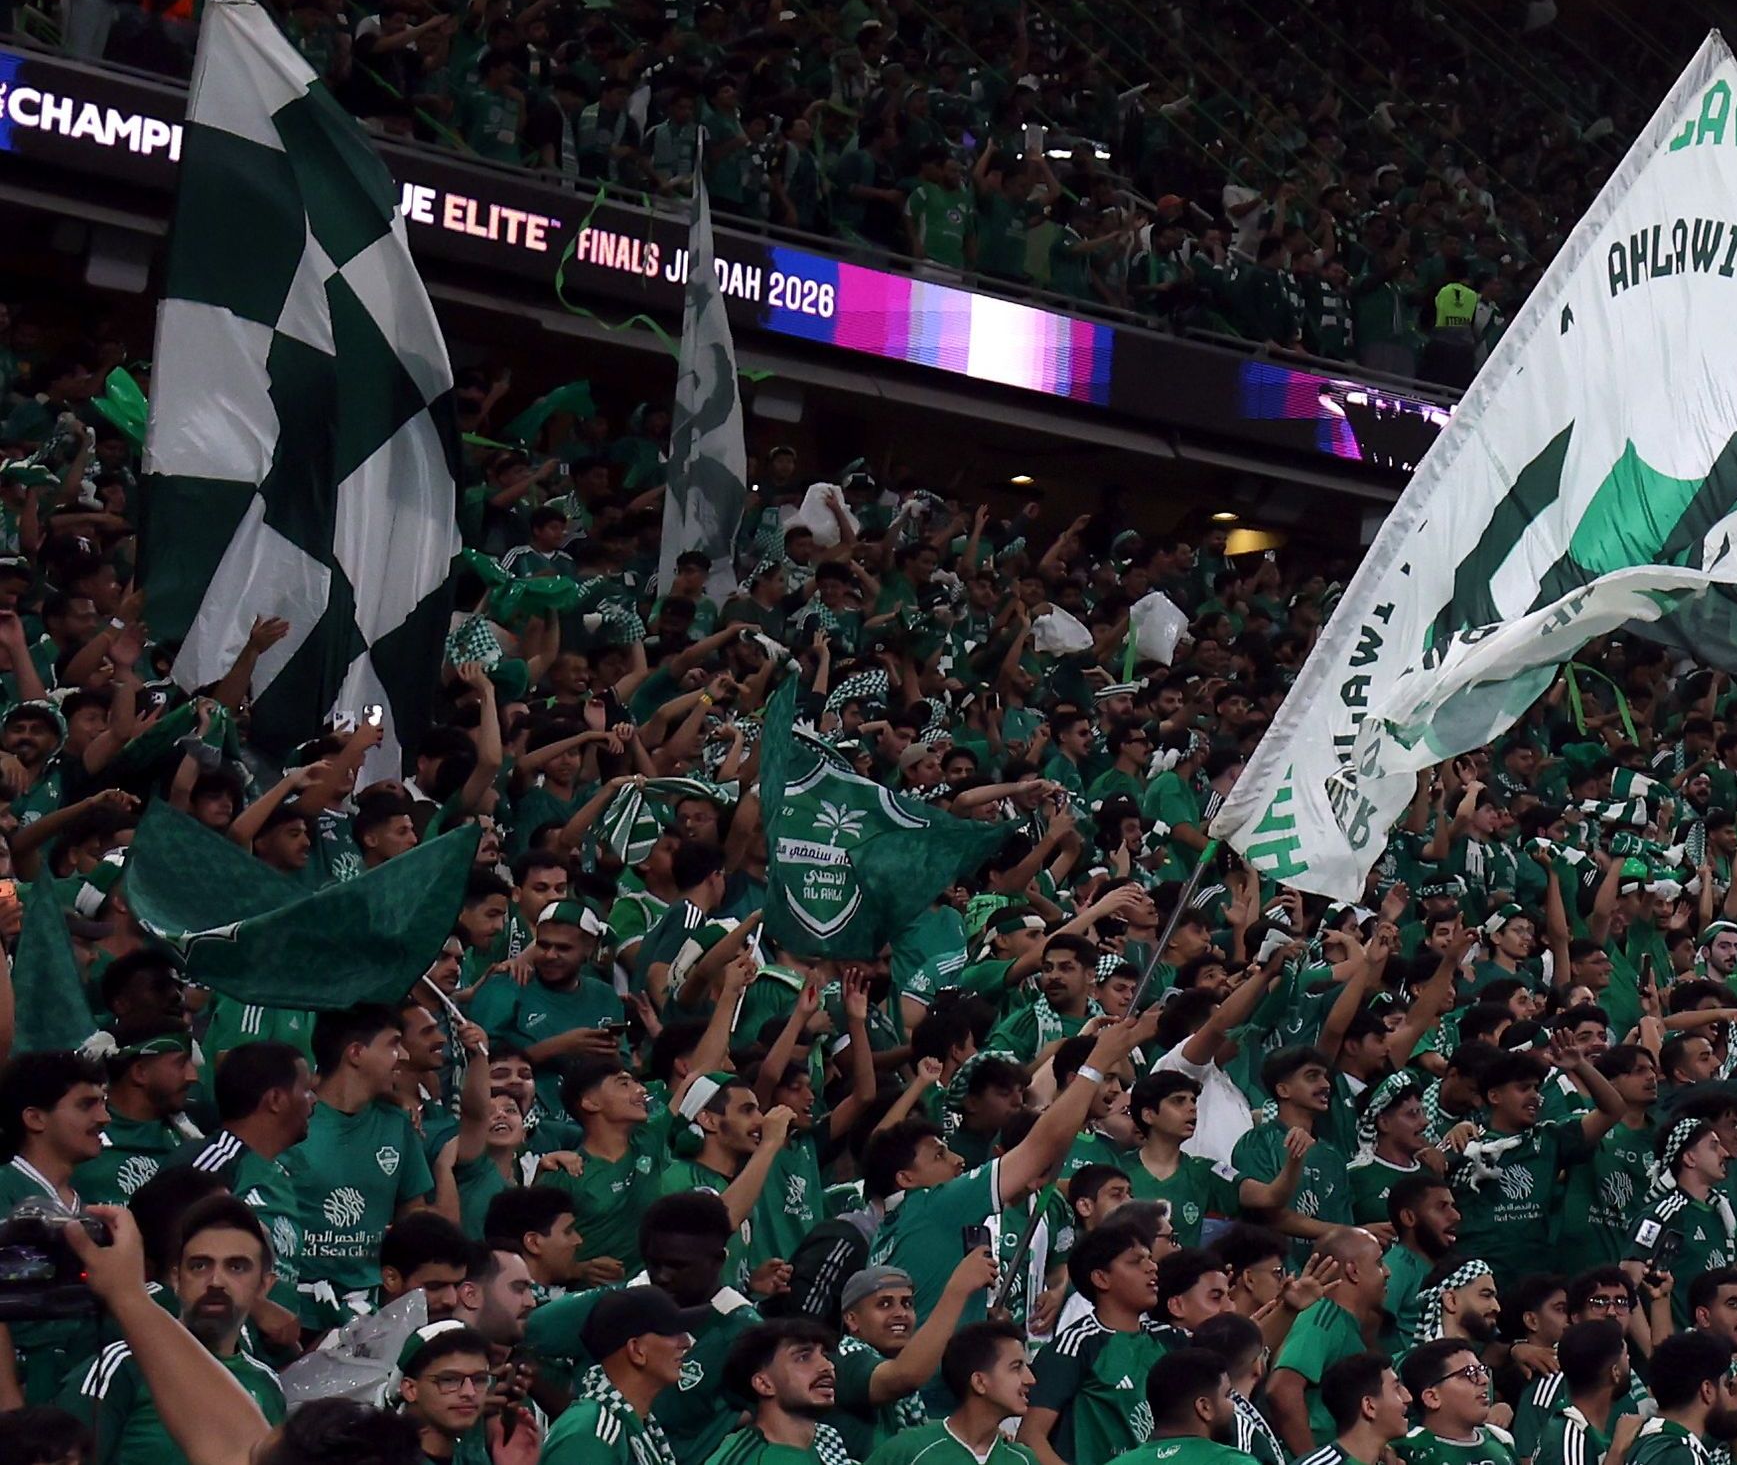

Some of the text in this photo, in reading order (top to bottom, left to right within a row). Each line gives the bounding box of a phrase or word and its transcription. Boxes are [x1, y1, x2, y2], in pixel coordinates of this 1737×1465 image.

[7, 87, 184, 162] CHAMPI
[576, 227, 660, 278] FINALS
[768, 271, 836, 318] 2026
[301, 1245, 317, 1257] ed
[319, 1245, 346, 1257] Sea
